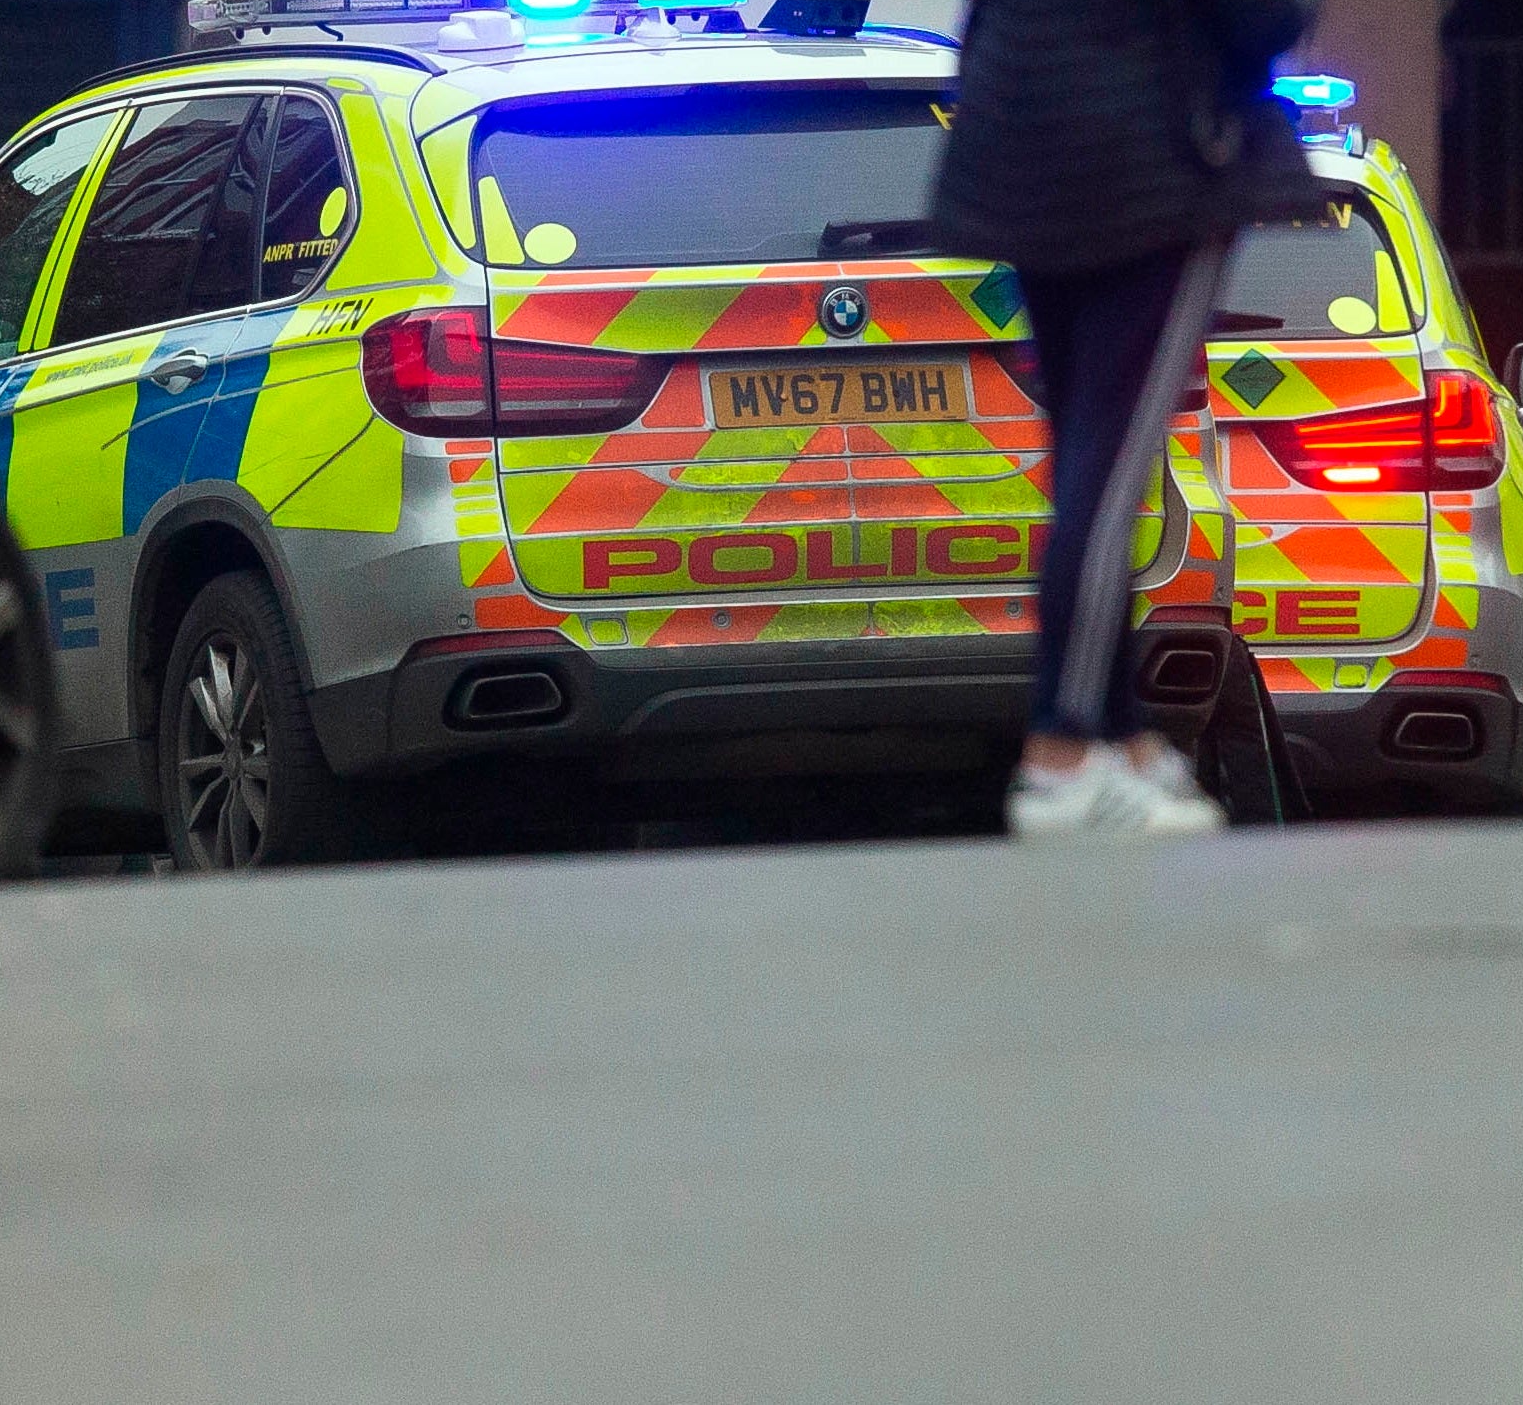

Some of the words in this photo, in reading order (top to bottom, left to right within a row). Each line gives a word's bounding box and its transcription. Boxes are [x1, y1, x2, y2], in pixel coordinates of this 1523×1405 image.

[262, 243, 295, 264] ANPR
[298, 237, 340, 259] FITTED
[730, 372, 845, 418] MV67
[860, 369, 950, 414] BWH
[582, 523, 1053, 590] POLIC
